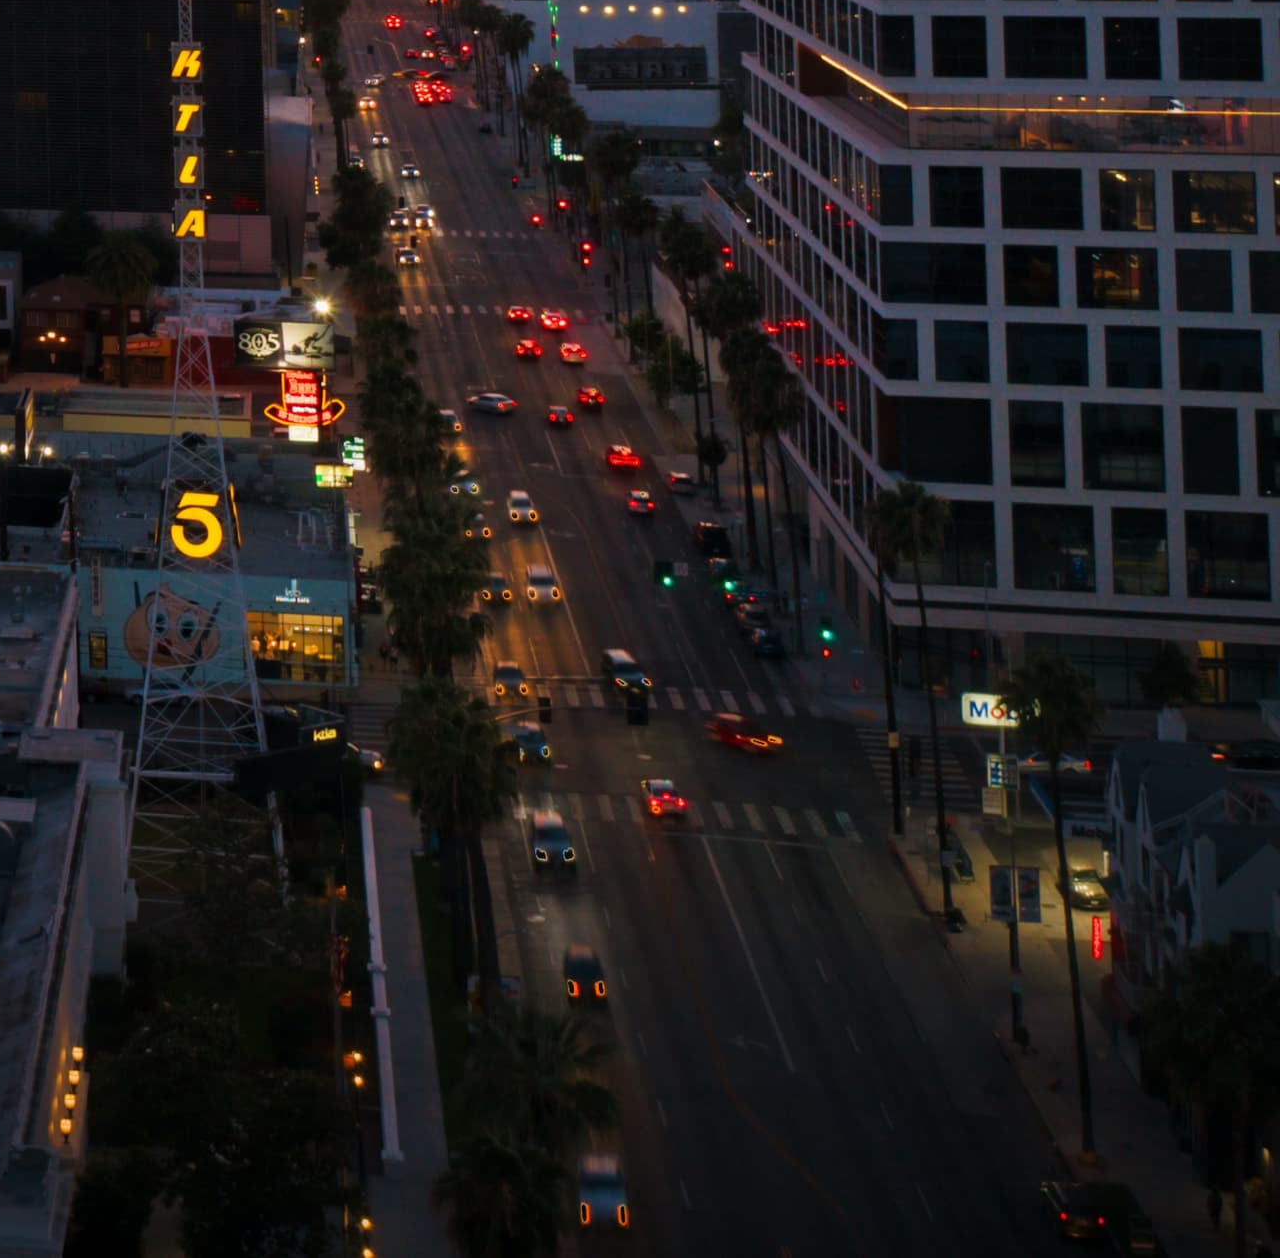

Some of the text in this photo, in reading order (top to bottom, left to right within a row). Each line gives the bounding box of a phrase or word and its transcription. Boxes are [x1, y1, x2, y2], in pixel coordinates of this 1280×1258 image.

[171, 49, 206, 238] KTLA
[238, 332, 281, 352] 805
[170, 491, 223, 558] 5
[312, 727, 337, 742] ktla
